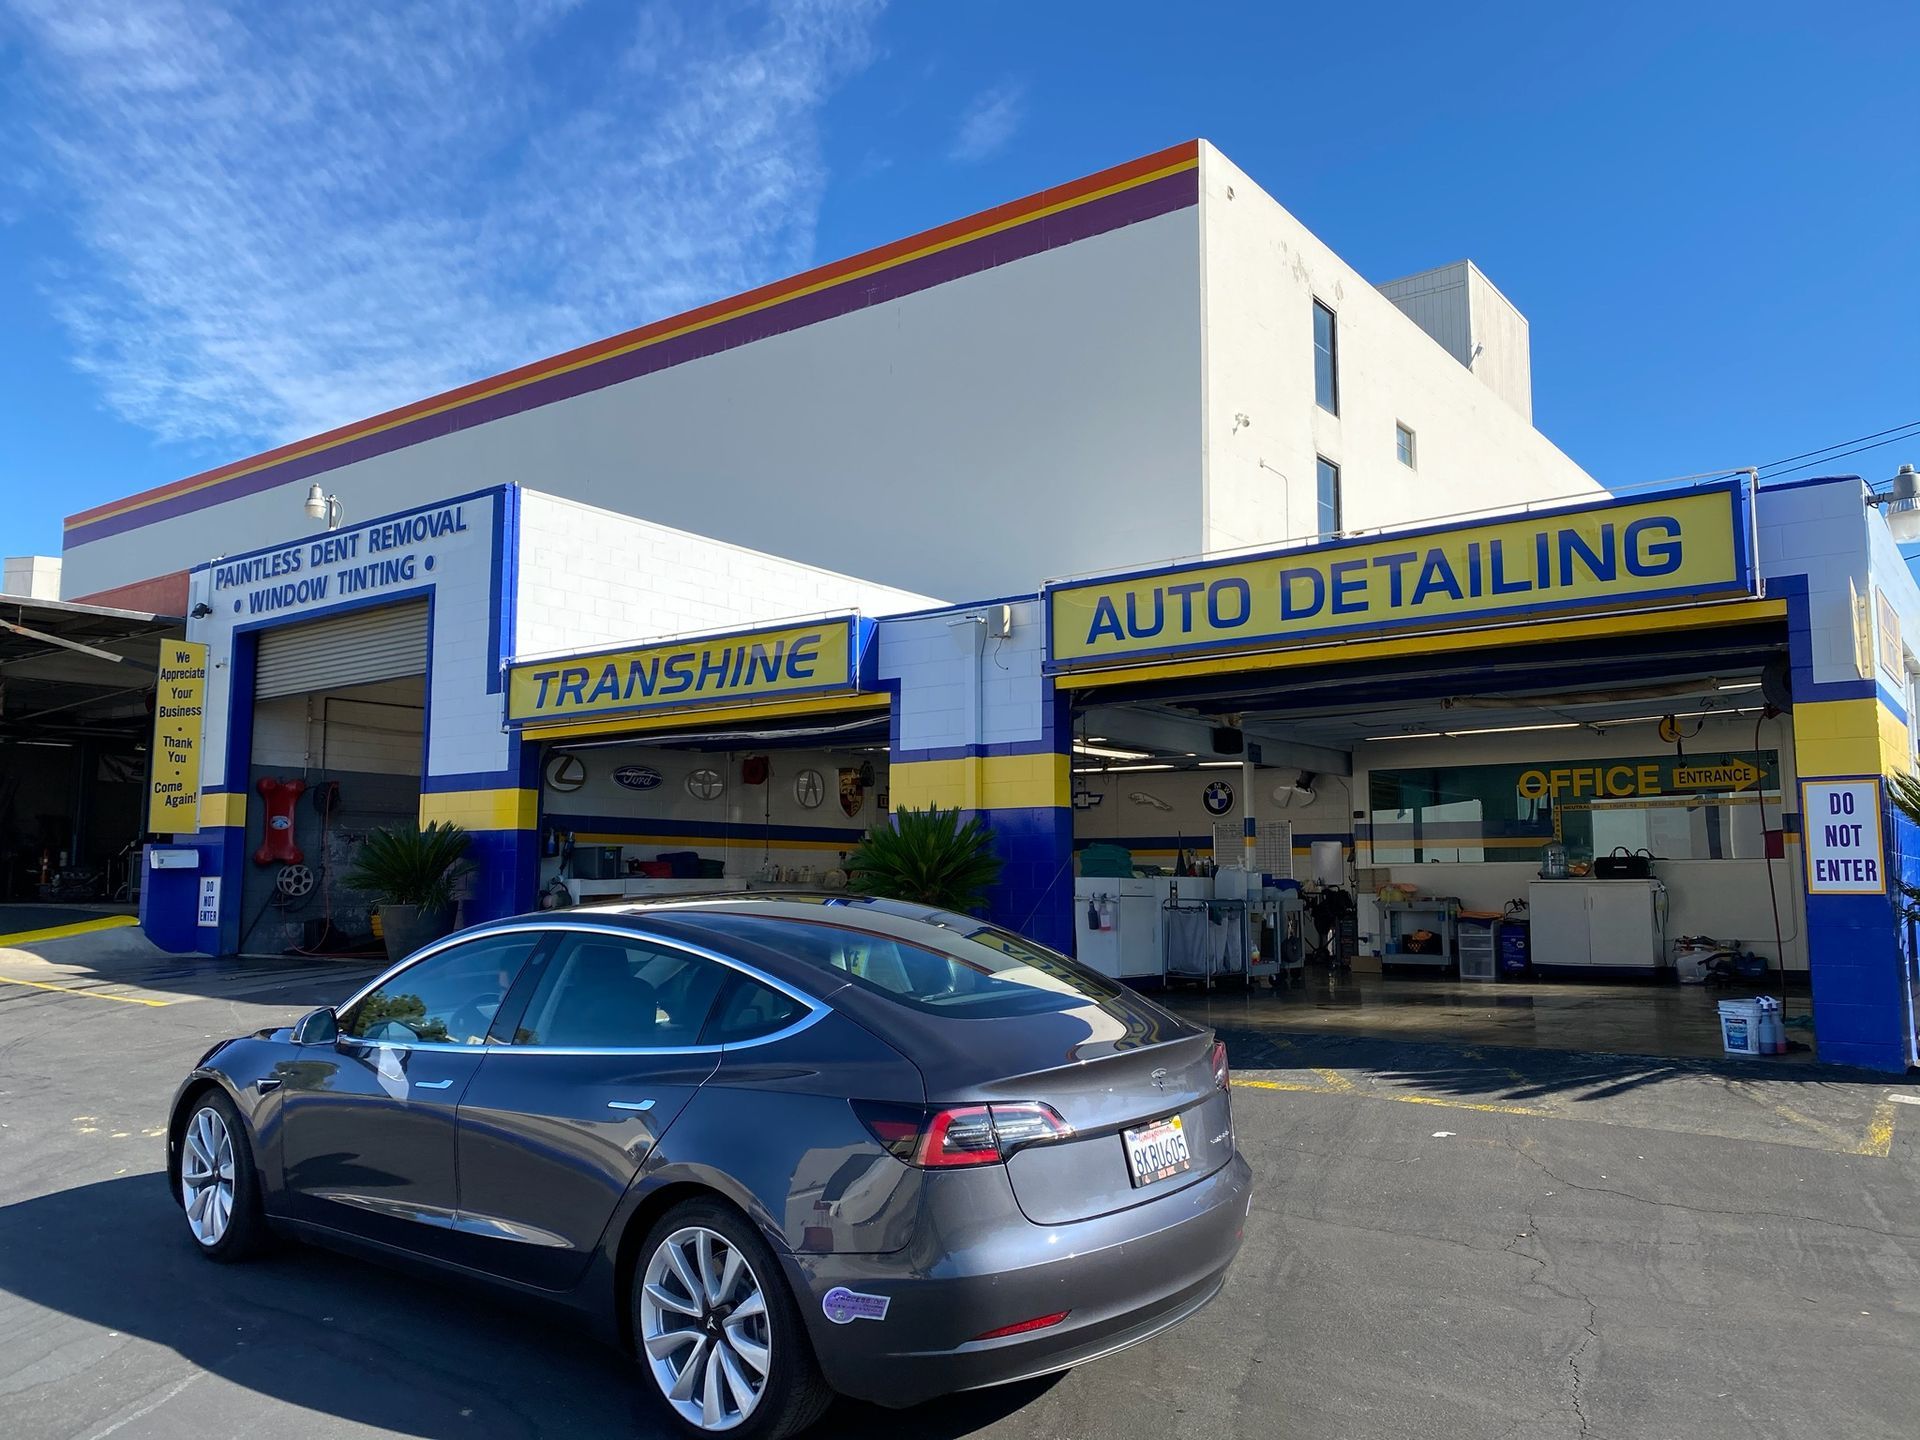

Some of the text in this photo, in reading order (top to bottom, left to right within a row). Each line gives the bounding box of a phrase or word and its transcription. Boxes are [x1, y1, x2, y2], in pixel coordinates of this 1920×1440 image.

[216, 506, 467, 590] PAINTLESS DENT REMOVAL
[249, 555, 415, 614] WINDOW TINTING
[1086, 516, 1683, 645] AUTO DETAILING
[175, 651, 190, 664] We
[160, 667, 205, 682] Appreciate
[533, 634, 822, 709] TRANSHINE
[171, 687, 193, 699] Your
[160, 705, 202, 718] Business
[163, 735, 193, 749] Thank
[168, 751, 186, 763] You
[154, 782, 183, 794] Come
[1518, 764, 1752, 799] OFFICE ENTRANCE
[165, 792, 197, 808] Again!
[1829, 792, 1854, 815] DO
[1825, 825, 1862, 847] NOT
[1816, 859, 1878, 882] ENTER
[206, 881, 214, 892] DO
[203, 896, 215, 907] NOT
[200, 910, 217, 921] ENTER
[1134, 1135, 1187, 1175] 8KBU605
